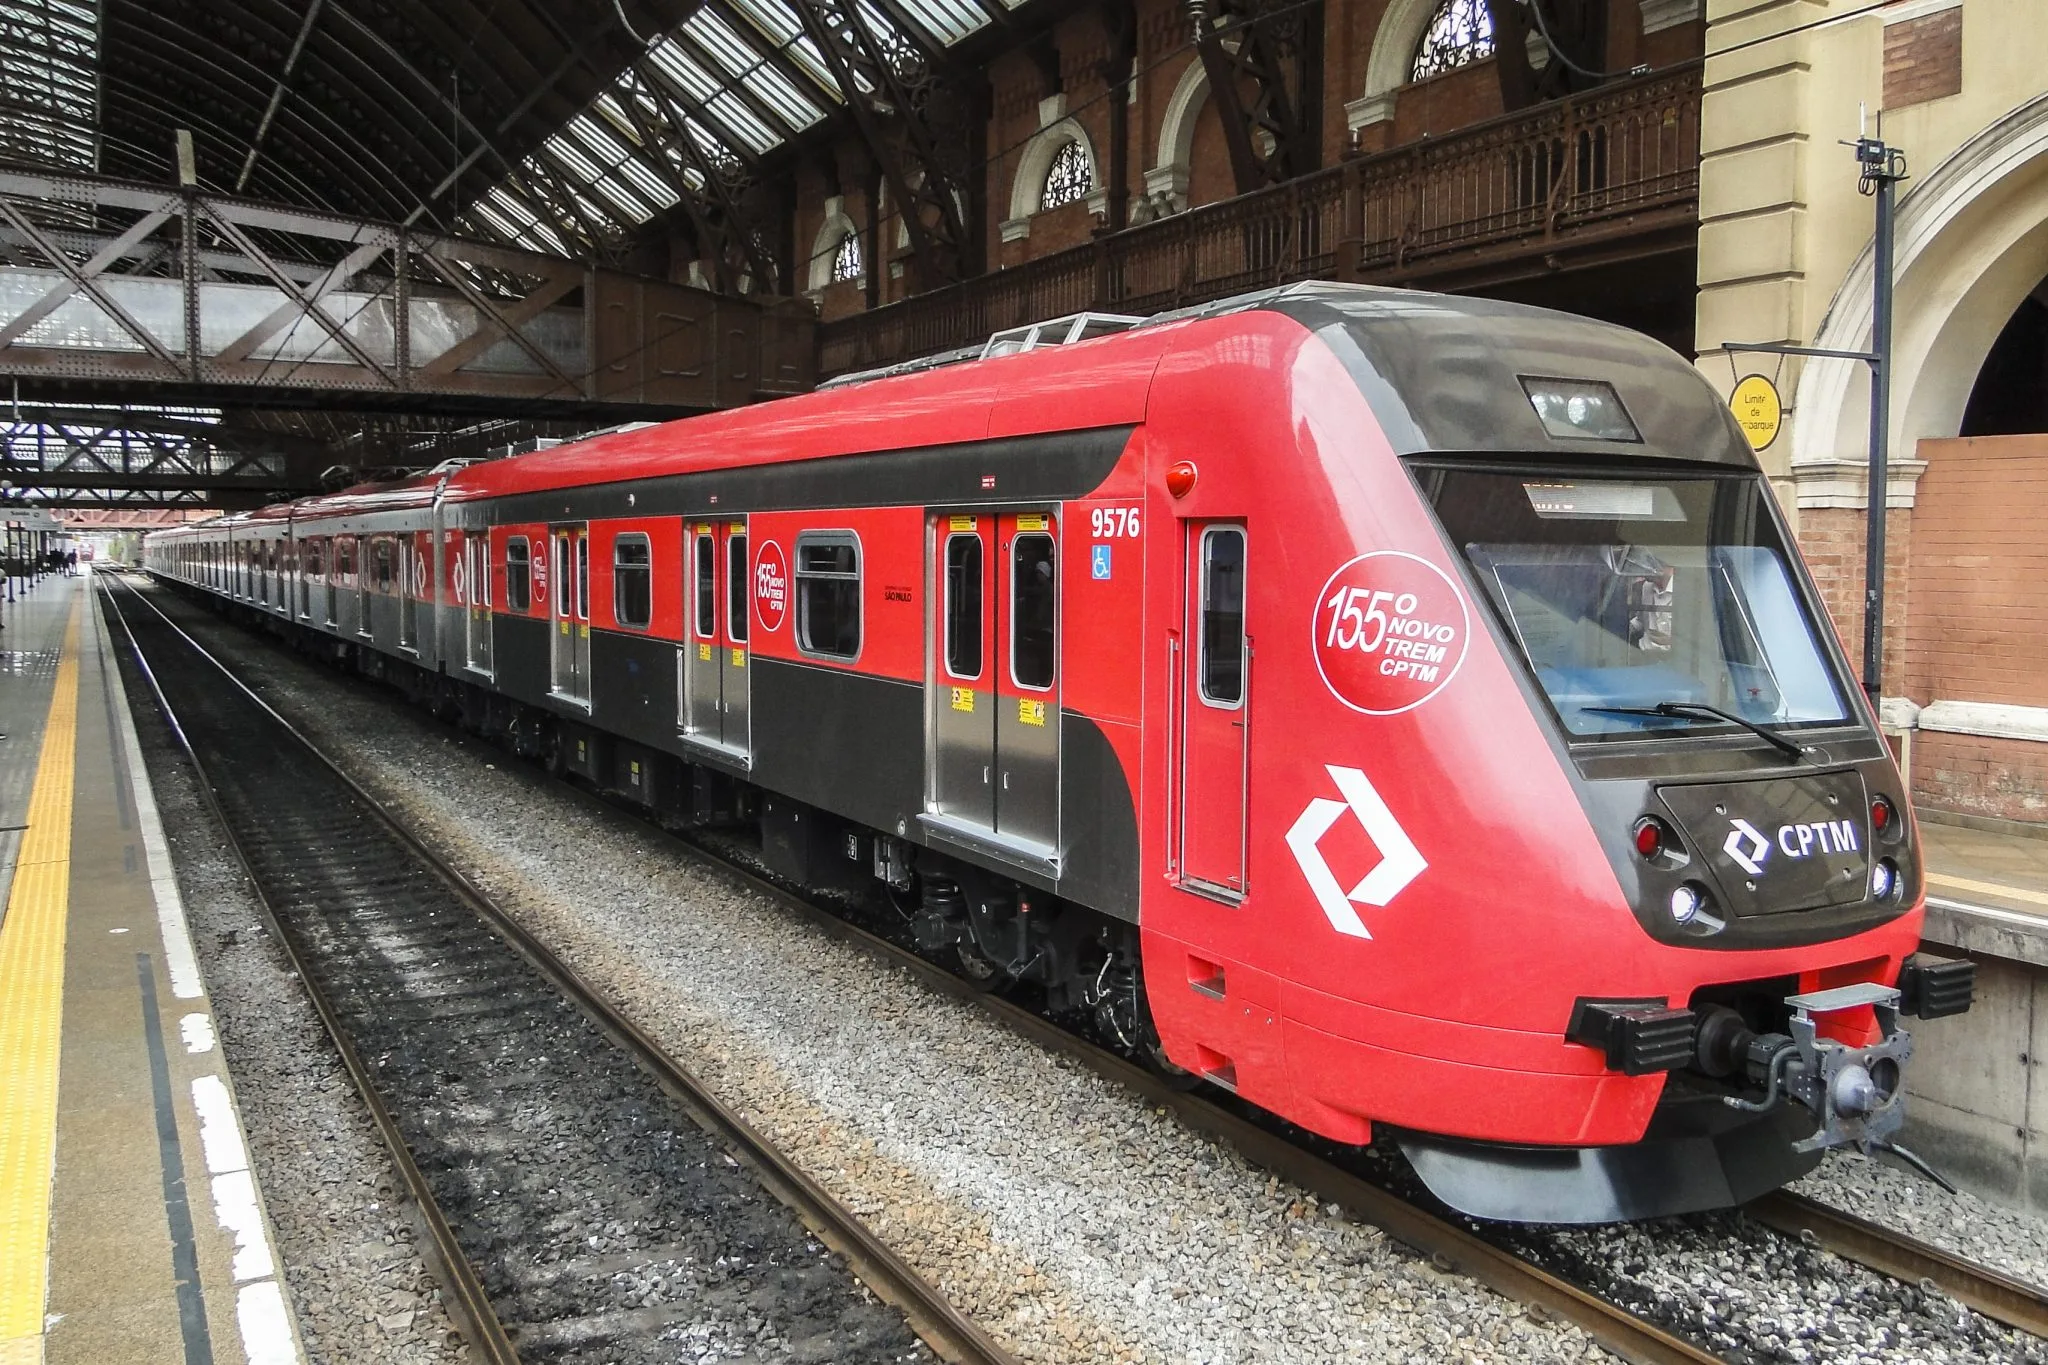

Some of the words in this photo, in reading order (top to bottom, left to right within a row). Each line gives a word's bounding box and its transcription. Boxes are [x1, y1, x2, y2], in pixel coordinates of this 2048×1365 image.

[1750, 406, 1760, 417] de
[1091, 507, 1140, 538] 9576
[756, 562, 771, 599] 155
[1394, 593, 1418, 615] O
[1326, 585, 1395, 653] 155
[1387, 616, 1455, 643] NOVO
[1384, 637, 1447, 663] TREM
[1379, 658, 1440, 683] CPTM
[1777, 819, 1858, 858] CPTM
